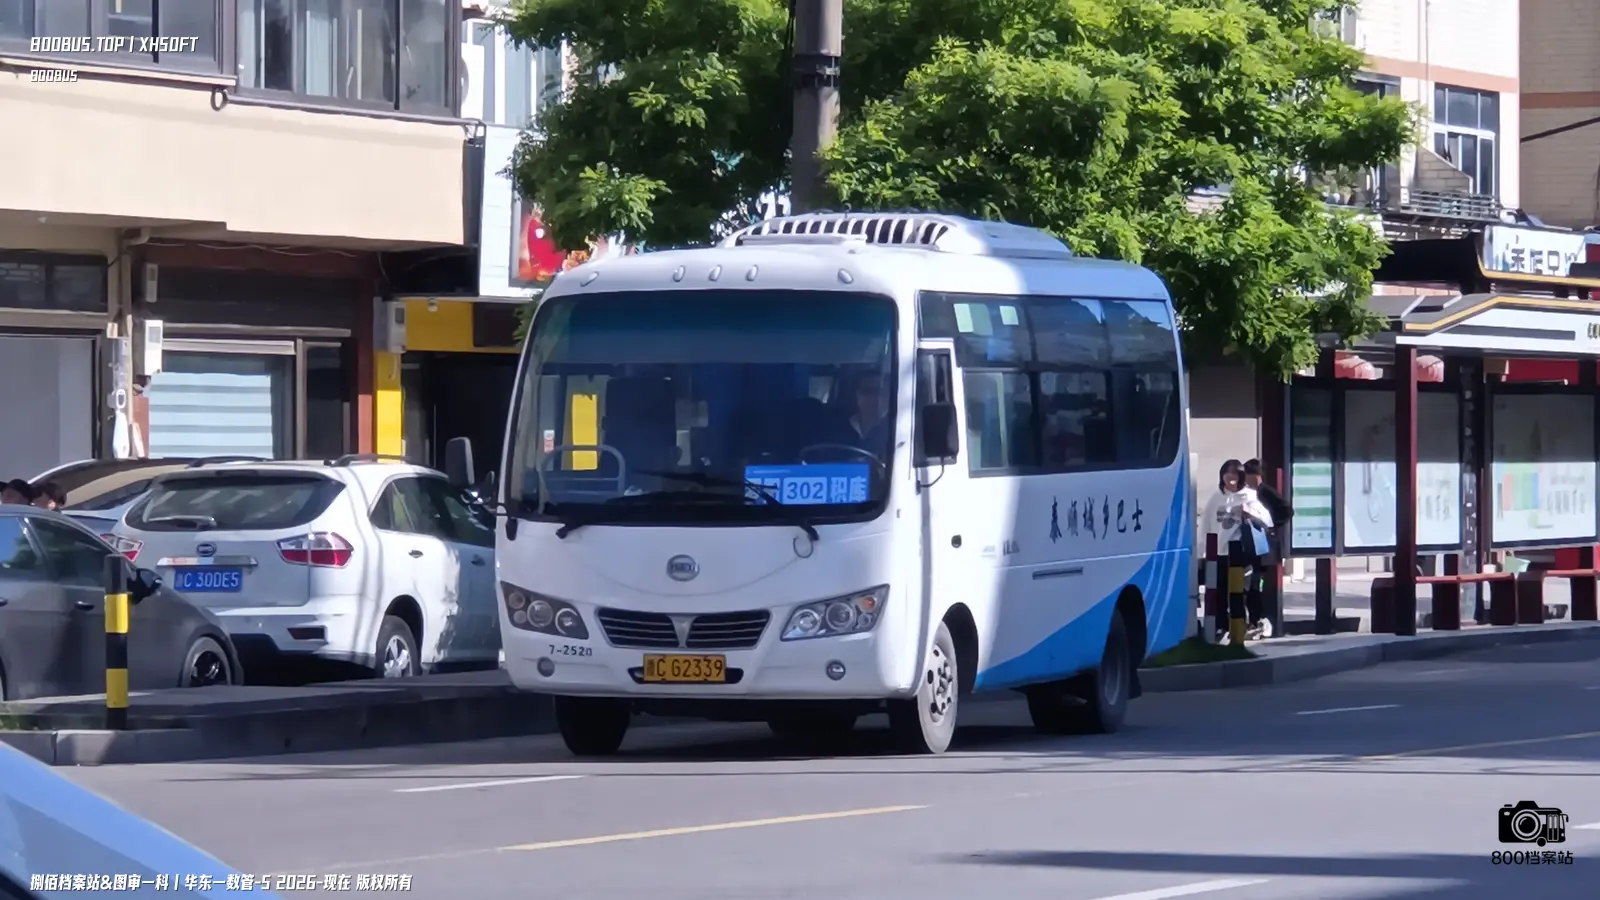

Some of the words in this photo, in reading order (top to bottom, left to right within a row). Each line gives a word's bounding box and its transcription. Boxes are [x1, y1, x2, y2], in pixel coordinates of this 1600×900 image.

[786, 481, 825, 500] 302
[549, 644, 592, 657] 7-2520
[671, 658, 724, 678] G2339
